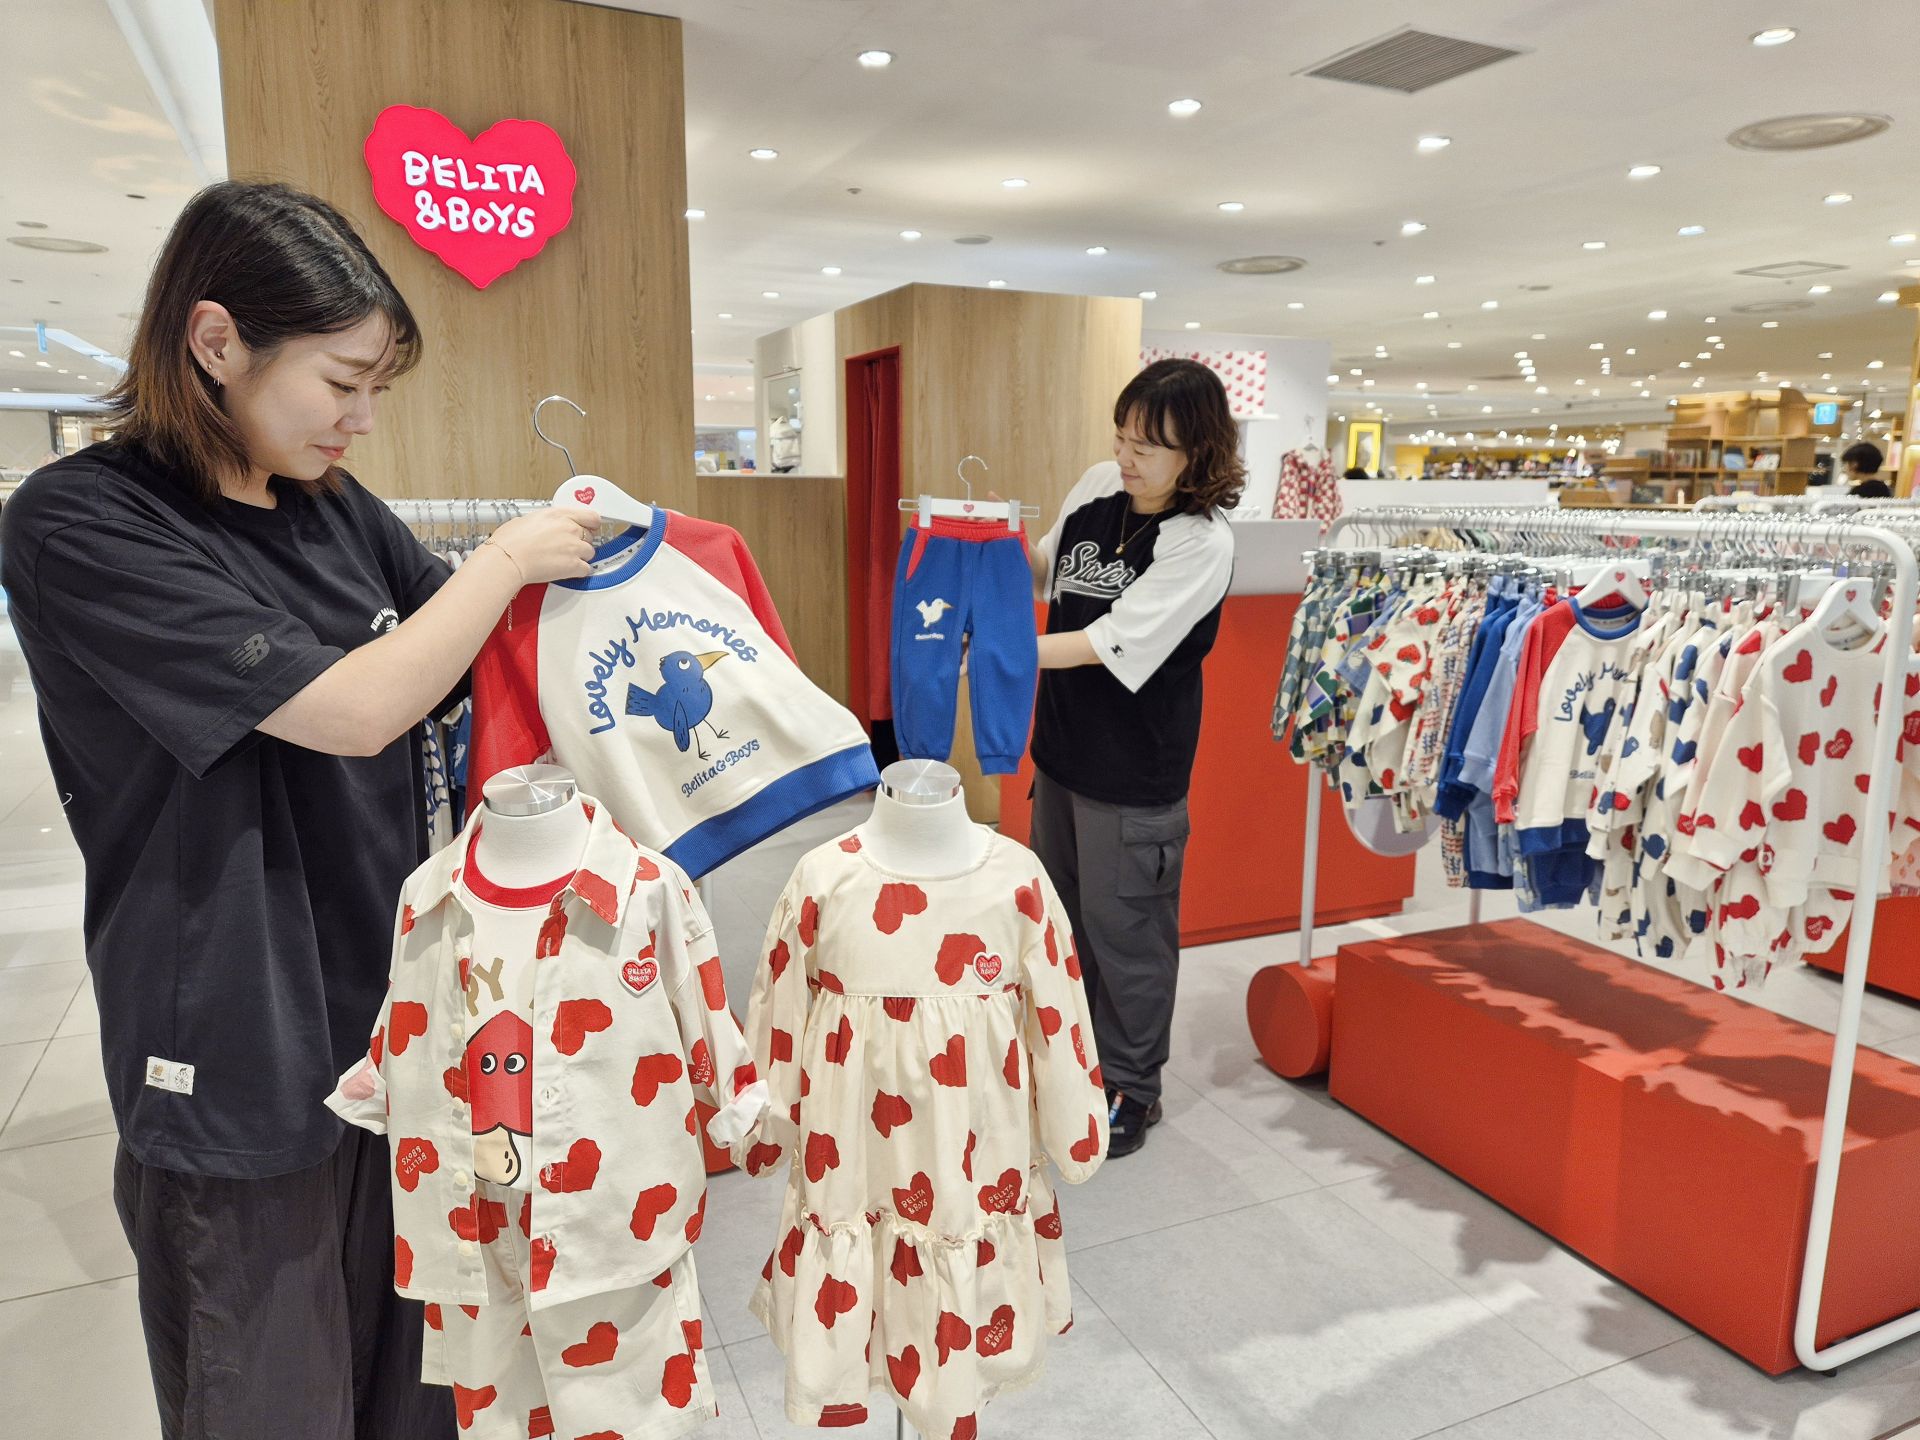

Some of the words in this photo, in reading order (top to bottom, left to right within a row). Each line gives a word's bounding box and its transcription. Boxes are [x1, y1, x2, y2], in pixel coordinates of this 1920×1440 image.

[401, 150, 546, 197] BELITA
[584, 638, 636, 735] Lovely
[625, 607, 759, 663] Memories
[1554, 670, 1597, 722] Lovely
[404, 1152, 428, 1175] BELITA
[900, 1188, 927, 1209] BELITA
[988, 1183, 1014, 1204] BELITA
[983, 1318, 1007, 1345] BELITA
